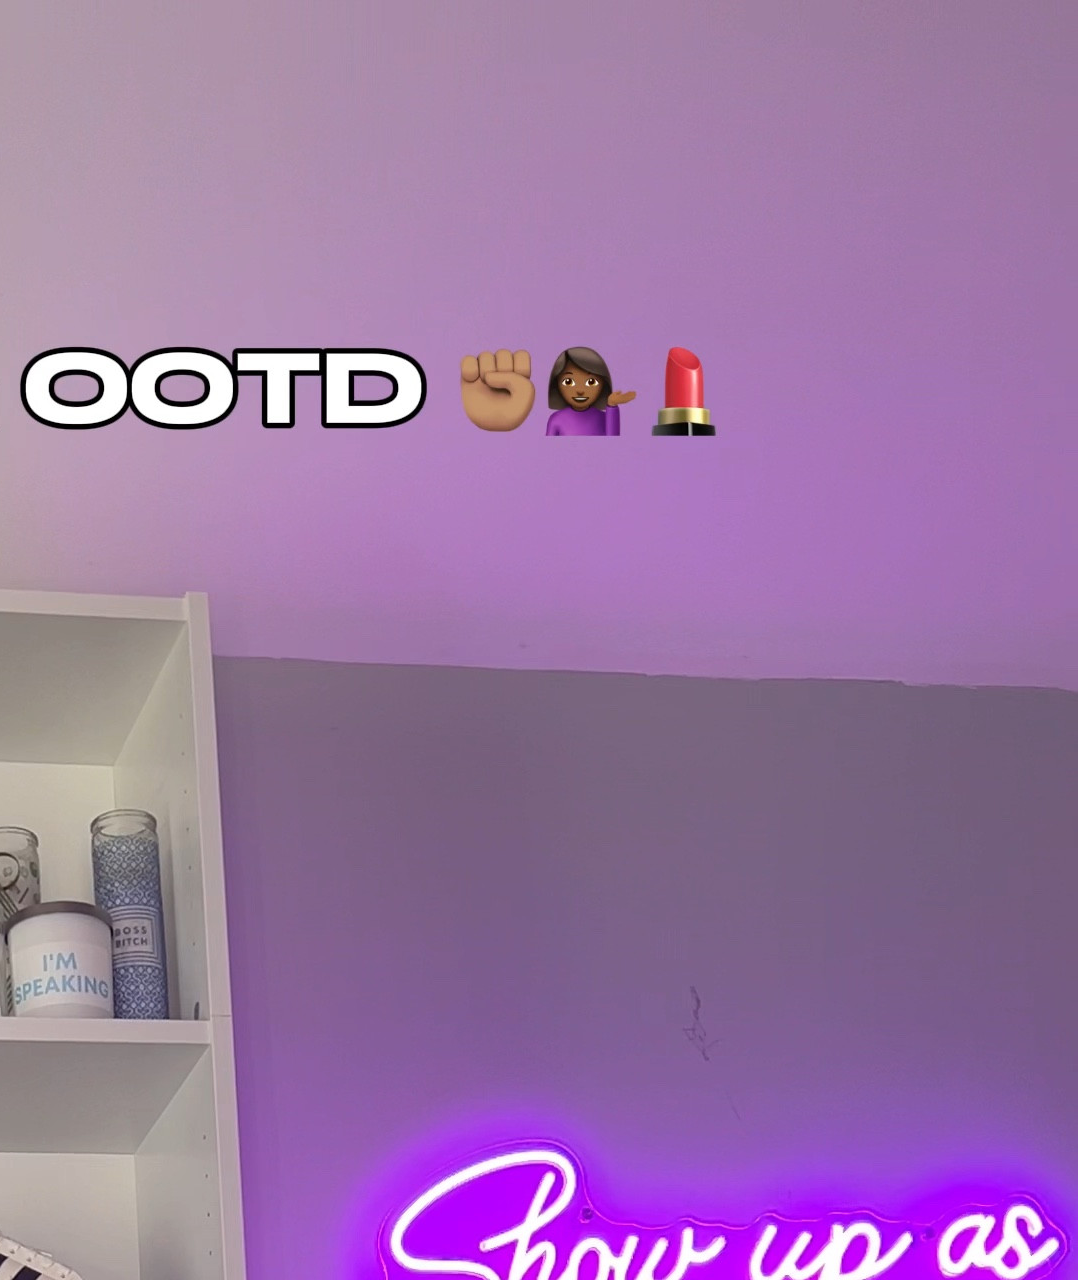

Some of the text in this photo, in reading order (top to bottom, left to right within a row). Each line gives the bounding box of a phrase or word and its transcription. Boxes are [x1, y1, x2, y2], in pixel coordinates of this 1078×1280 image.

[114, 925, 148, 937] BOSS
[115, 936, 148, 949] BITCH
[42, 951, 78, 971] I'M
[13, 974, 110, 1006] SPEAKING
[935, 1203, 1061, 1280] as
